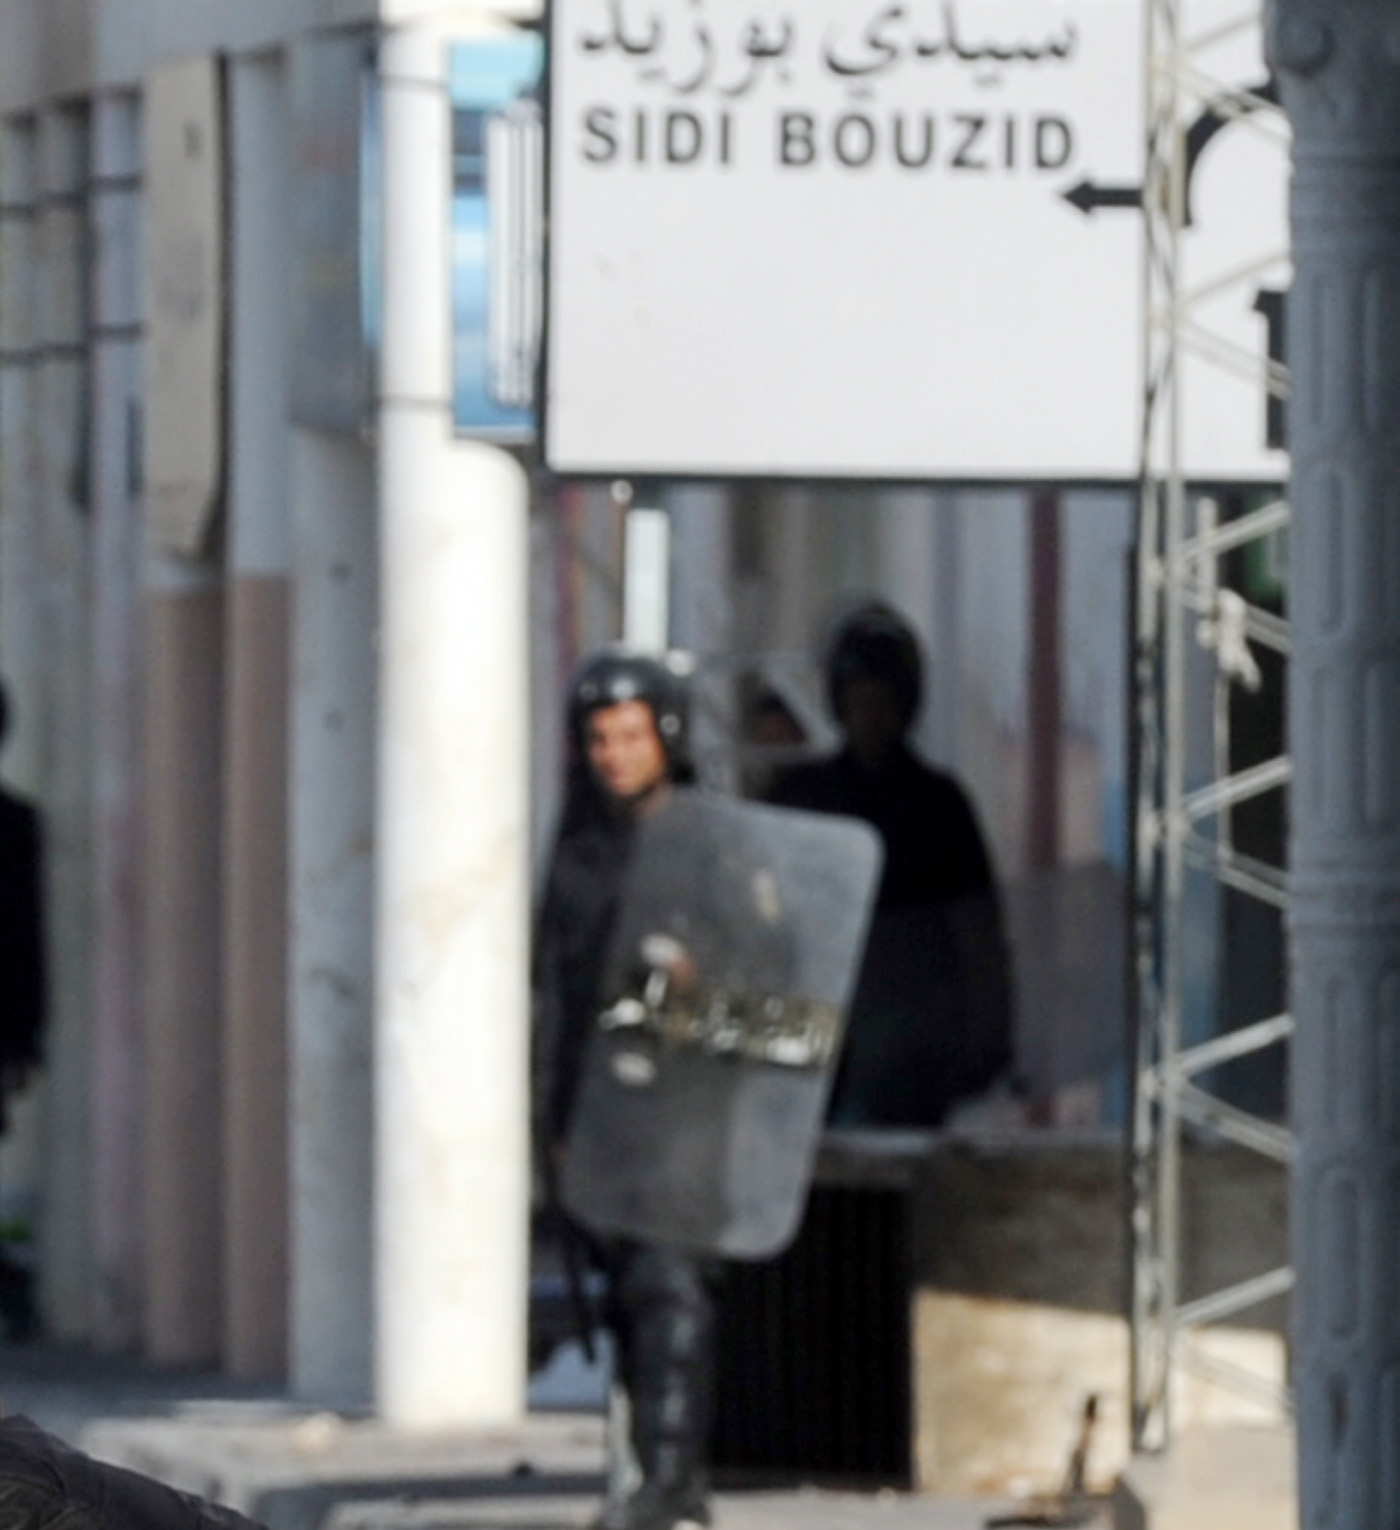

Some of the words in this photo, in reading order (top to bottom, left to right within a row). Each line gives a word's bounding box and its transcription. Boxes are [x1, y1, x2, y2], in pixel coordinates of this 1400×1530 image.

[581, 0, 792, 97] بوزيد
[821, 0, 1078, 99] سيدي
[582, 106, 732, 166] SIDI
[778, 110, 1073, 170] BOUZID
